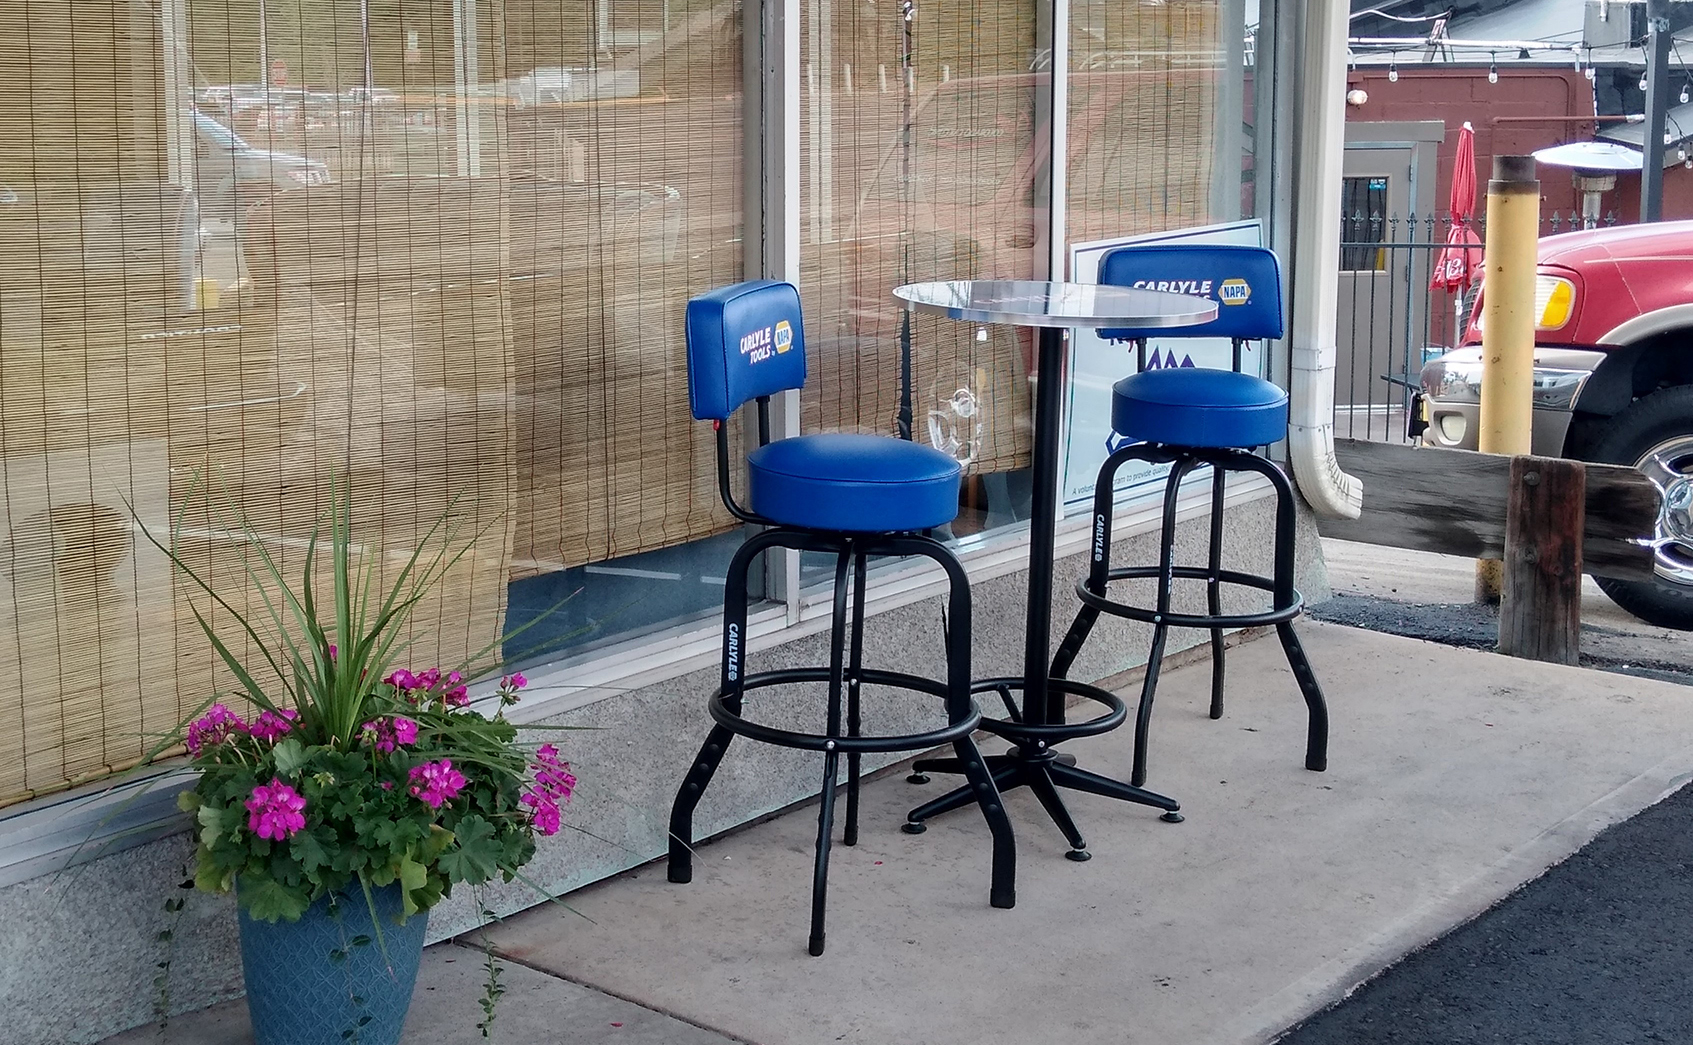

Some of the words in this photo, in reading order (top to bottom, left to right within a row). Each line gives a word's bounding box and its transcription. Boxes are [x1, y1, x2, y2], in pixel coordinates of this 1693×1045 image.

[1133, 281, 1211, 294] CARLYLE
[1223, 285, 1246, 298] NAPA
[740, 327, 770, 354] CARLYLE
[777, 329, 789, 346] NAPA
[750, 345, 770, 364] TOOLS
[1133, 469, 1152, 481] provide
[1095, 514, 1105, 554] CARLYLE
[728, 622, 739, 672] CARLYLE
